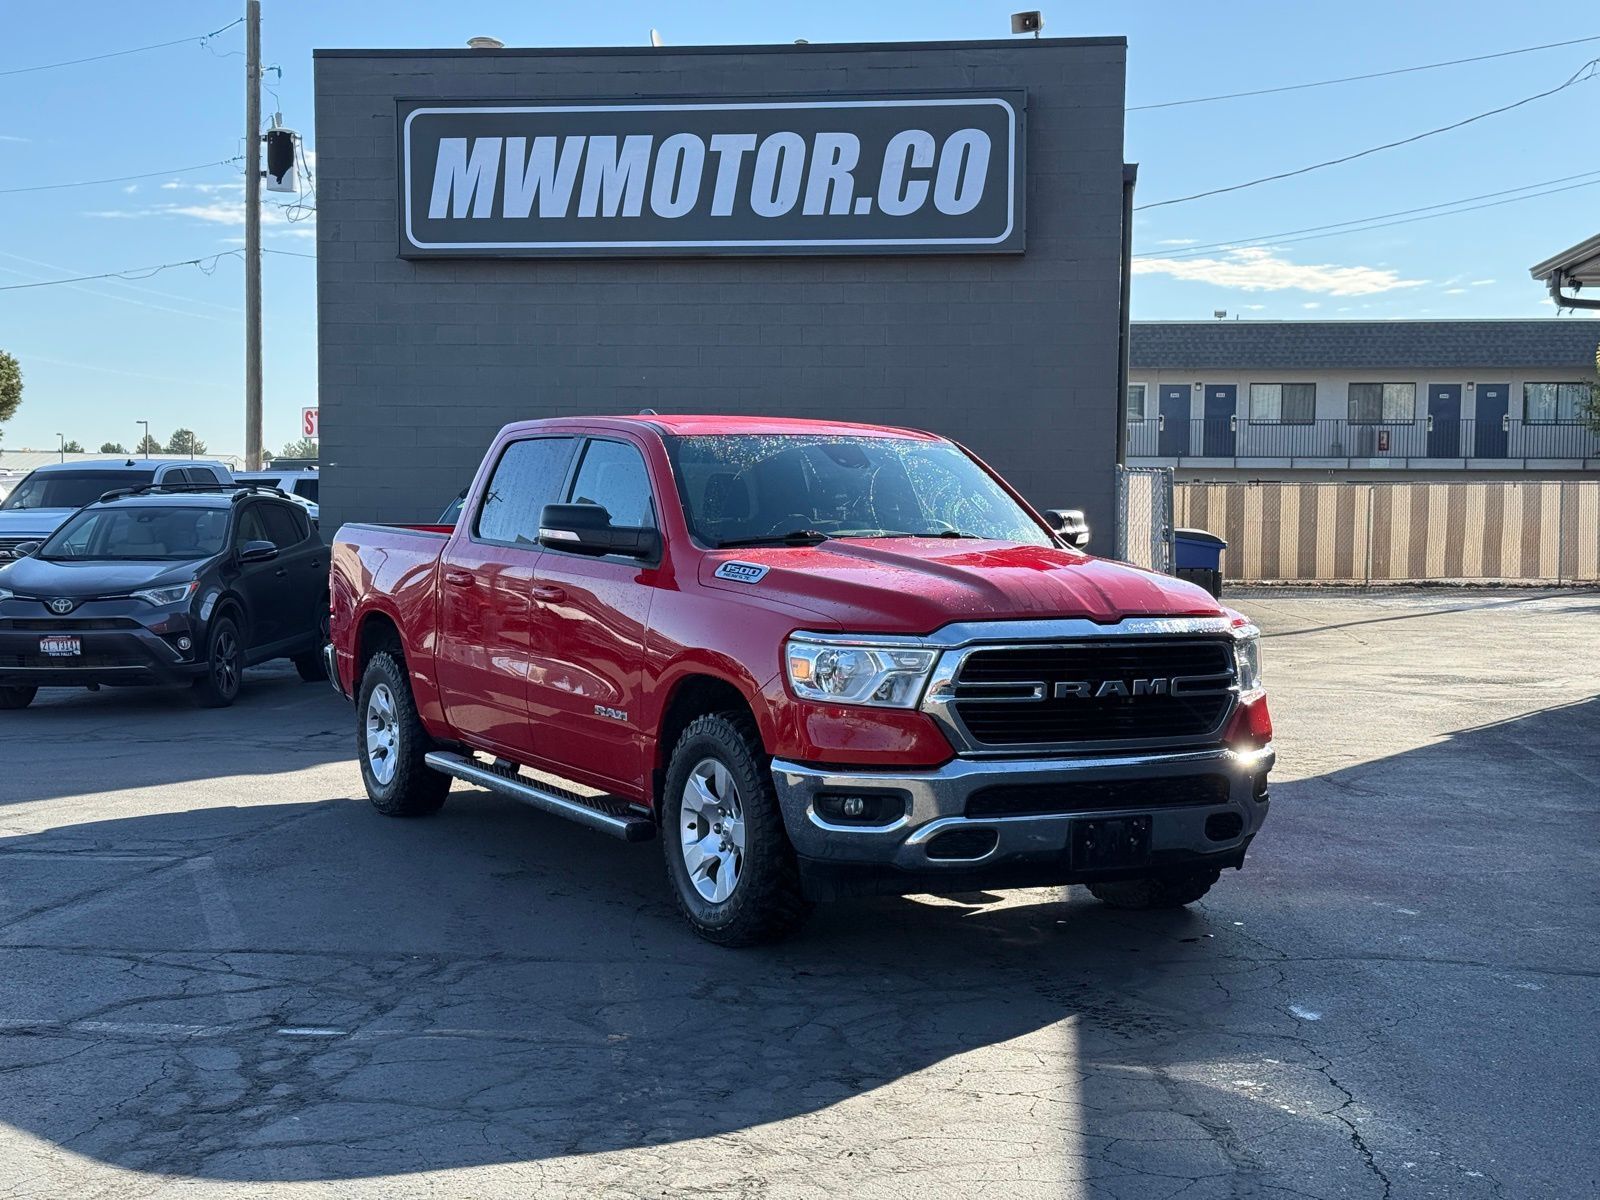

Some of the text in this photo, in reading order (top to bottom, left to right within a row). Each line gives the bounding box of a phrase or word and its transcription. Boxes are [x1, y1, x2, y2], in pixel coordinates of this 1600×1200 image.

[427, 128, 992, 219] MWMOTOR.CO
[725, 564, 760, 576] 1500
[1054, 678, 1167, 698] RAM
[594, 704, 628, 721] RAM
